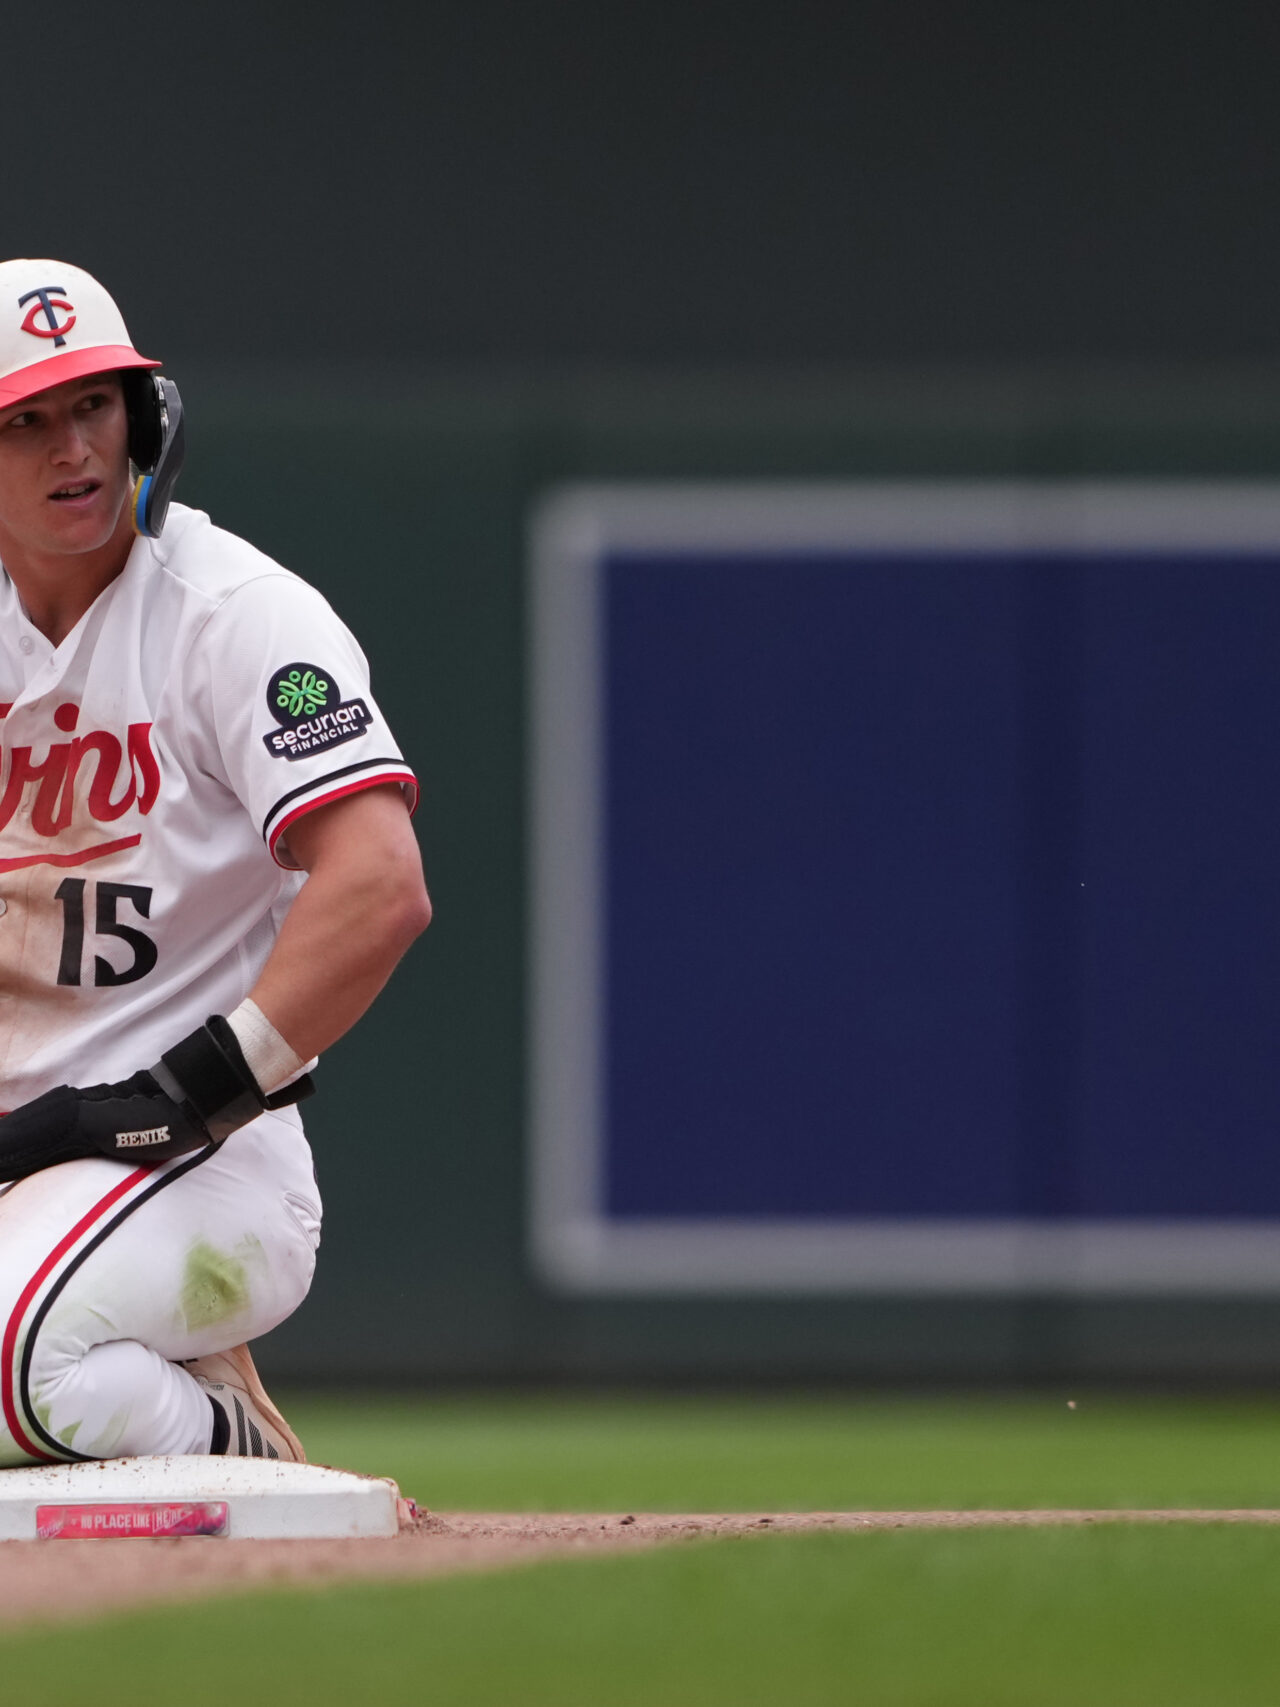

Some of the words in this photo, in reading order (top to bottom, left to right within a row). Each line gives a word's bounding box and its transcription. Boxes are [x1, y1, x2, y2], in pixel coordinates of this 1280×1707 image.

[271, 704, 365, 750] securian
[289, 722, 359, 754] FINANCIAL
[54, 877, 158, 987] 15
[115, 1125, 171, 1148] BENIK
[94, 1513, 131, 1529] PLACE
[133, 1512, 150, 1528] LIKE
